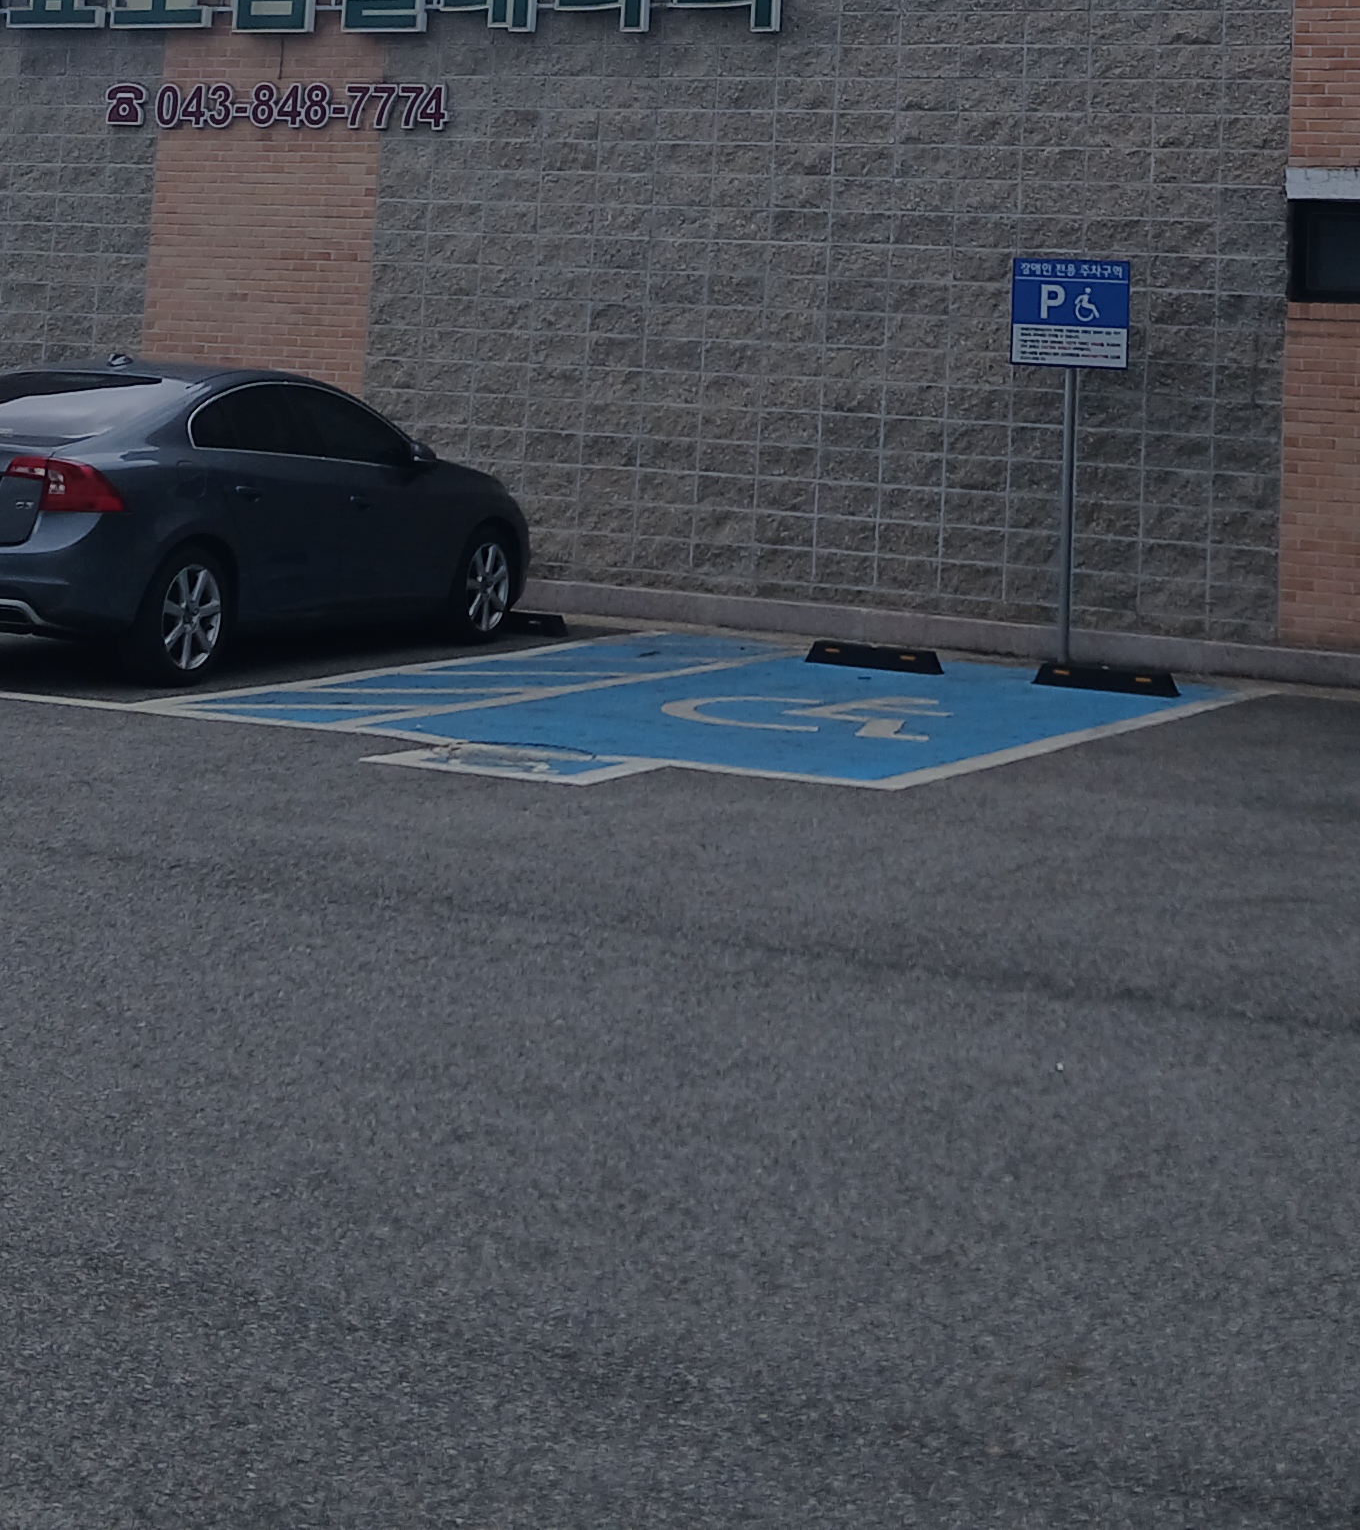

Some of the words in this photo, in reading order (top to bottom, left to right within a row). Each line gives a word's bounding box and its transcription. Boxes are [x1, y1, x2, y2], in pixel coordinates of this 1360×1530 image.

[156, 82, 447, 130] 043-848-7774
[1020, 262, 1052, 276] 장애인
[1055, 263, 1076, 277] 전용
[1079, 263, 1123, 279] 주차구역
[1040, 283, 1066, 319] P
